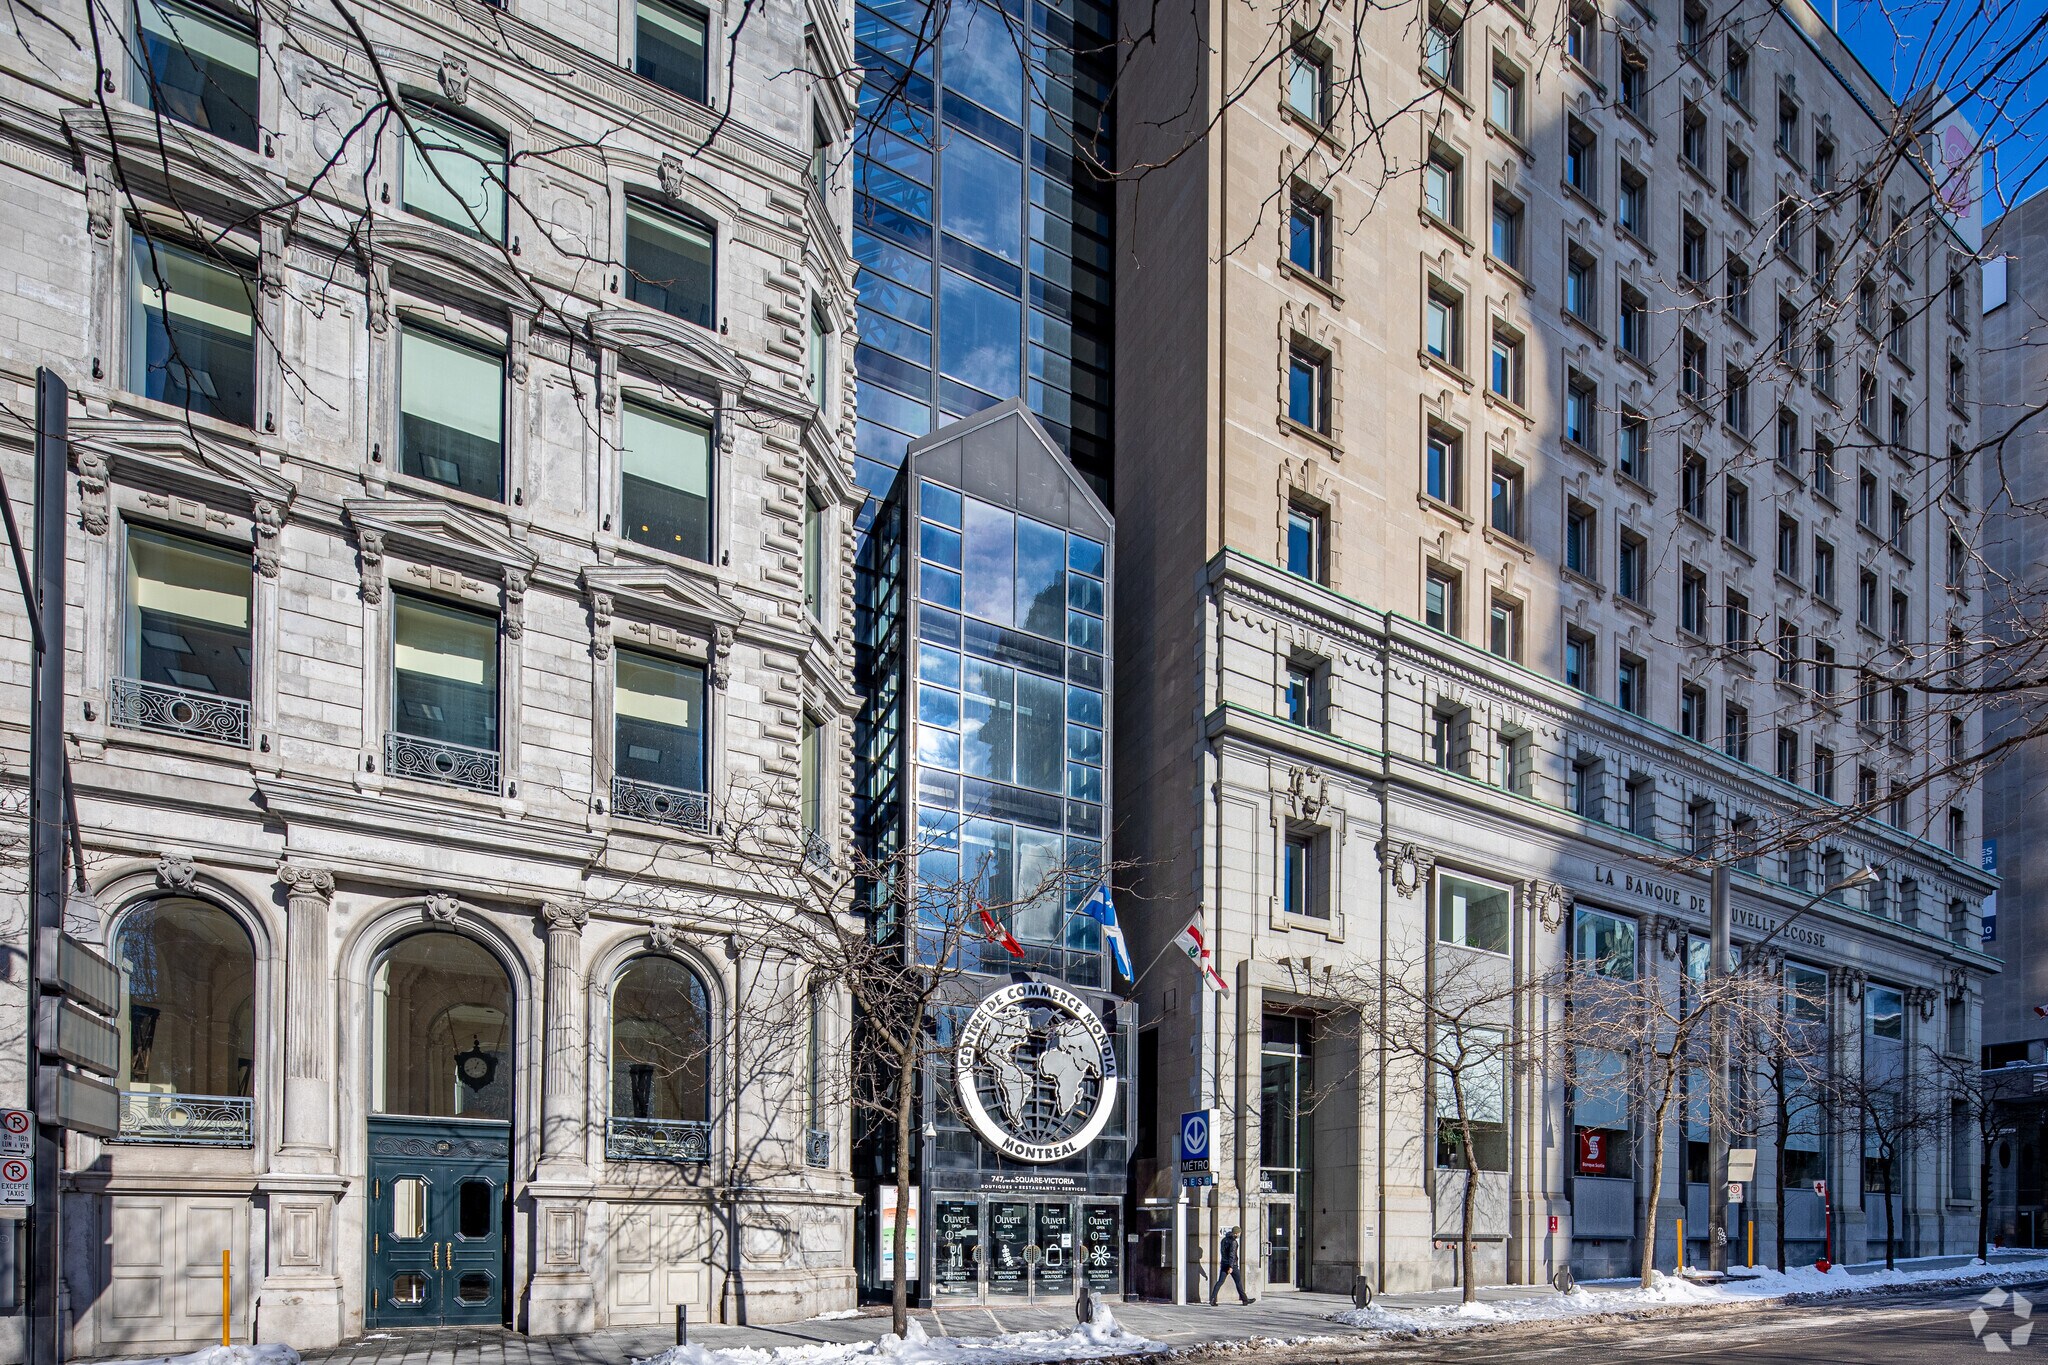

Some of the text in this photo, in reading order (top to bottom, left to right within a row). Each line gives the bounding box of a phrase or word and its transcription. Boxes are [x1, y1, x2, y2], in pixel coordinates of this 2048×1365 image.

[1596, 866, 1614, 886] LA
[1626, 875, 1680, 906] BANQUE
[1690, 895, 1705, 913] DE
[1732, 908, 1776, 932] UVELLE
[960, 984, 1116, 1080] CENTRE DE COMMERCE MONDIAL
[1002, 1138, 1076, 1159] MONTREAL
[1182, 1160, 1208, 1171] MÉTRO
[943, 1214, 970, 1223] Ouvert
[995, 1215, 1020, 1224] Ouvert
[1042, 1216, 1066, 1224] Ouvert
[1089, 1217, 1112, 1225] Ouvert
